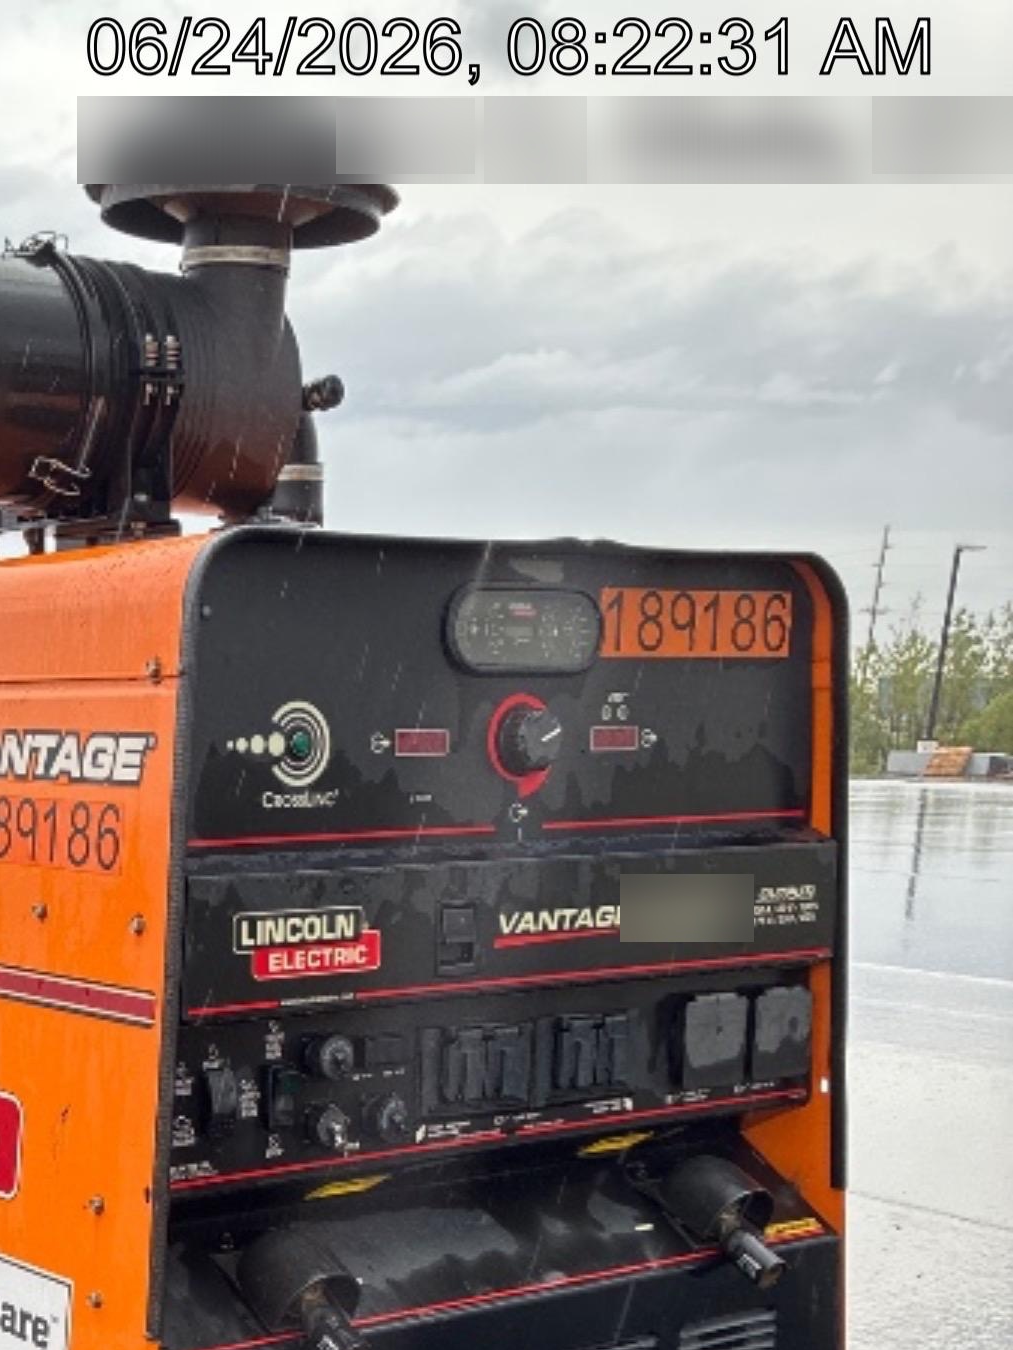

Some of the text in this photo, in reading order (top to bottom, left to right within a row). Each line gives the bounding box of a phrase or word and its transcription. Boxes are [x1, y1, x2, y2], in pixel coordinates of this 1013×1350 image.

[605, 592, 789, 655] 189186
[240, 912, 355, 946] LINCOLN
[268, 944, 367, 973] ELECTRIC
